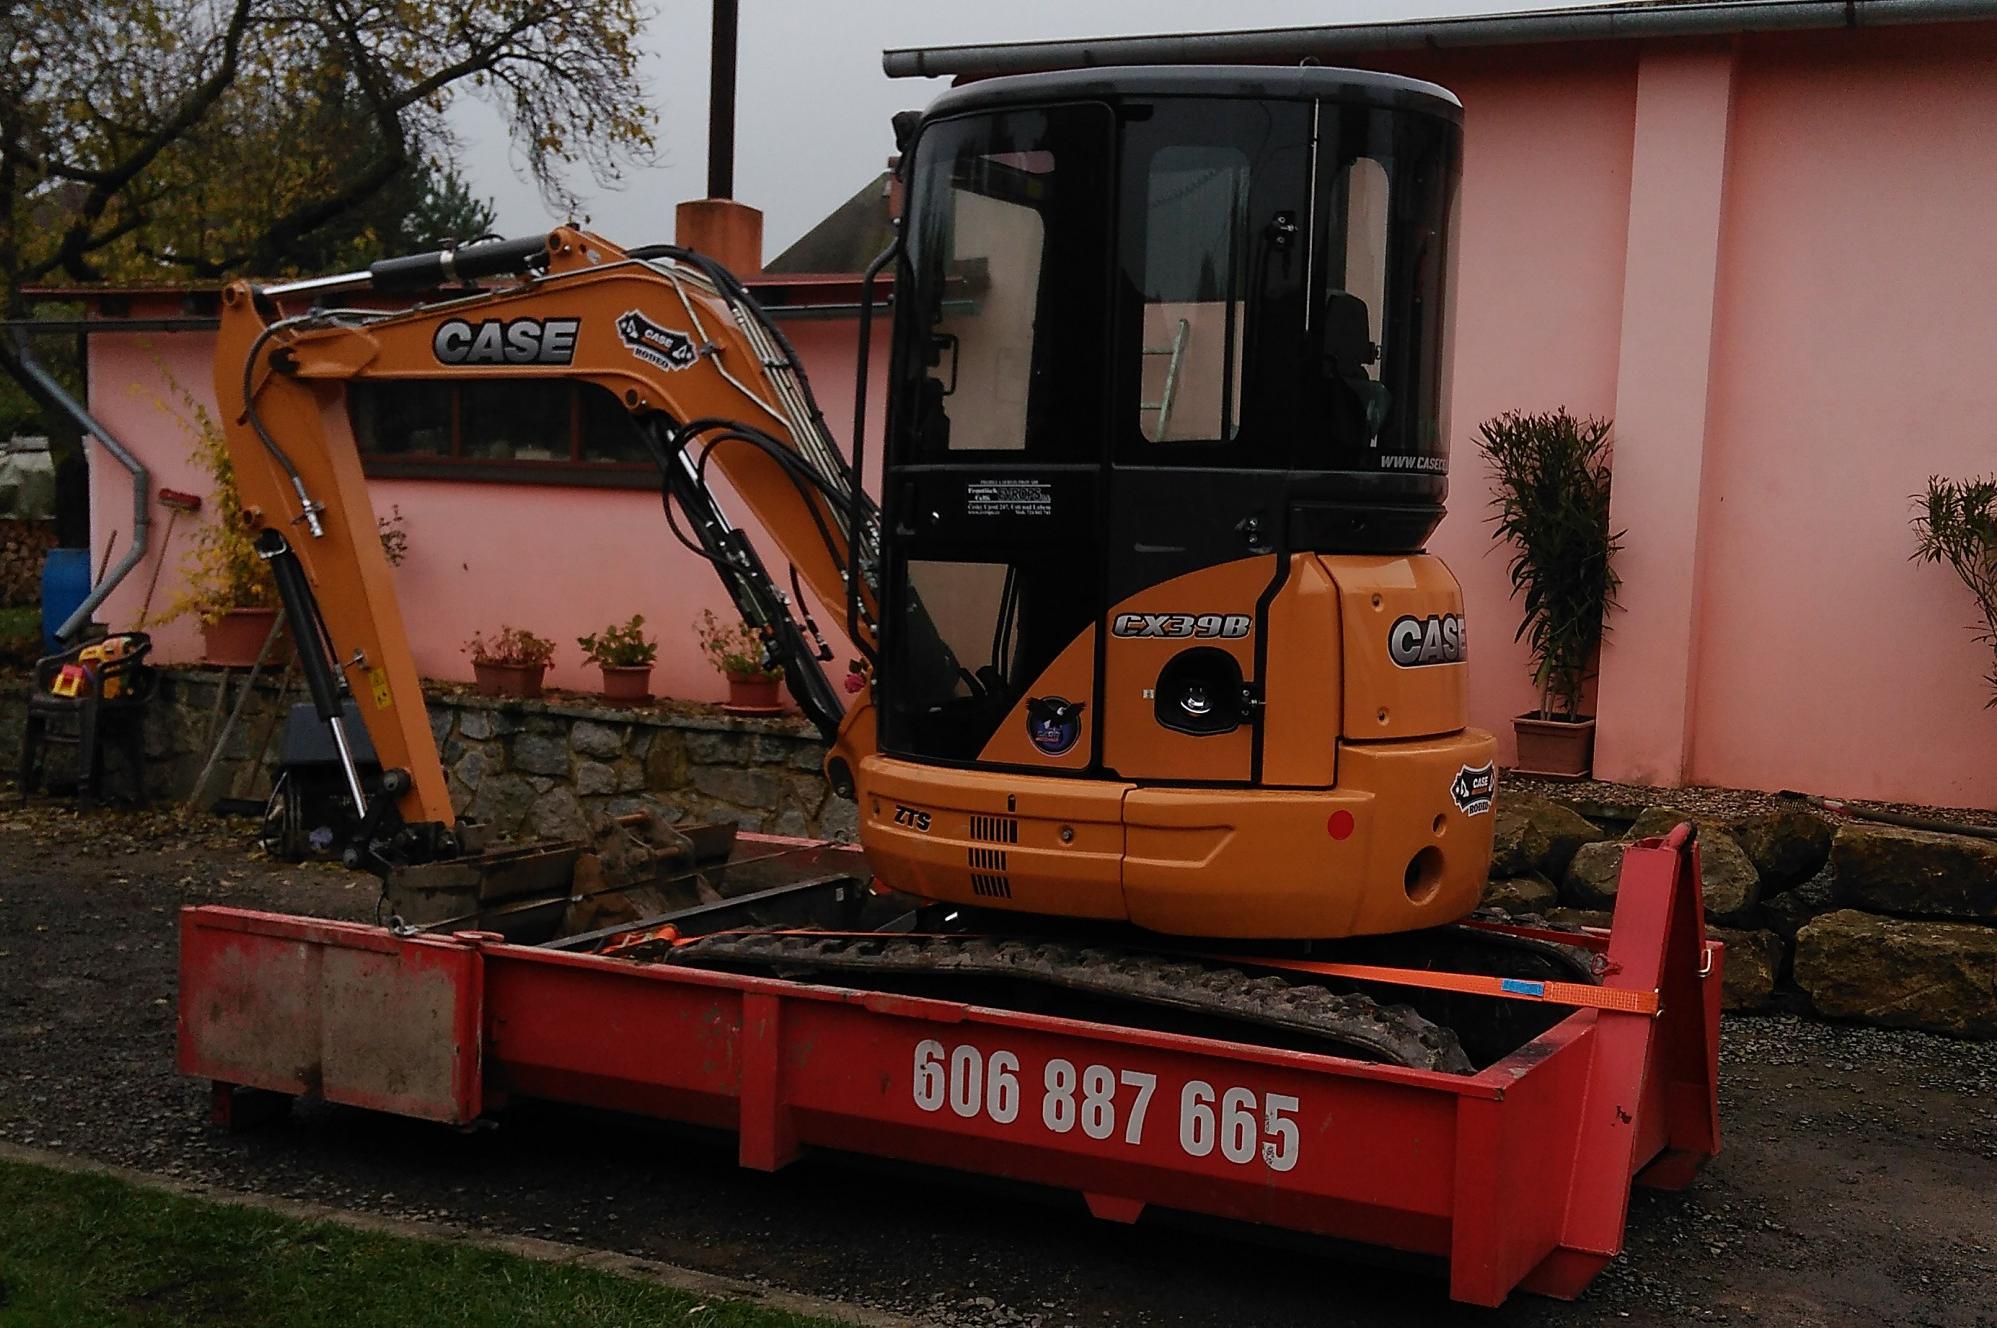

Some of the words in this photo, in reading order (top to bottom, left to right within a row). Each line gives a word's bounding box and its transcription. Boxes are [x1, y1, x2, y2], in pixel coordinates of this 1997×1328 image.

[433, 318, 580, 366] CASE
[644, 329, 674, 348] CASE
[1113, 613, 1252, 638] CX39B
[1389, 615, 1466, 667] CASE
[1472, 776, 1489, 788] CASE
[894, 804, 932, 832] ZTS
[913, 1039, 1020, 1124] 606
[1042, 1058, 1157, 1145] 887
[1179, 1080, 1300, 1172] 665
